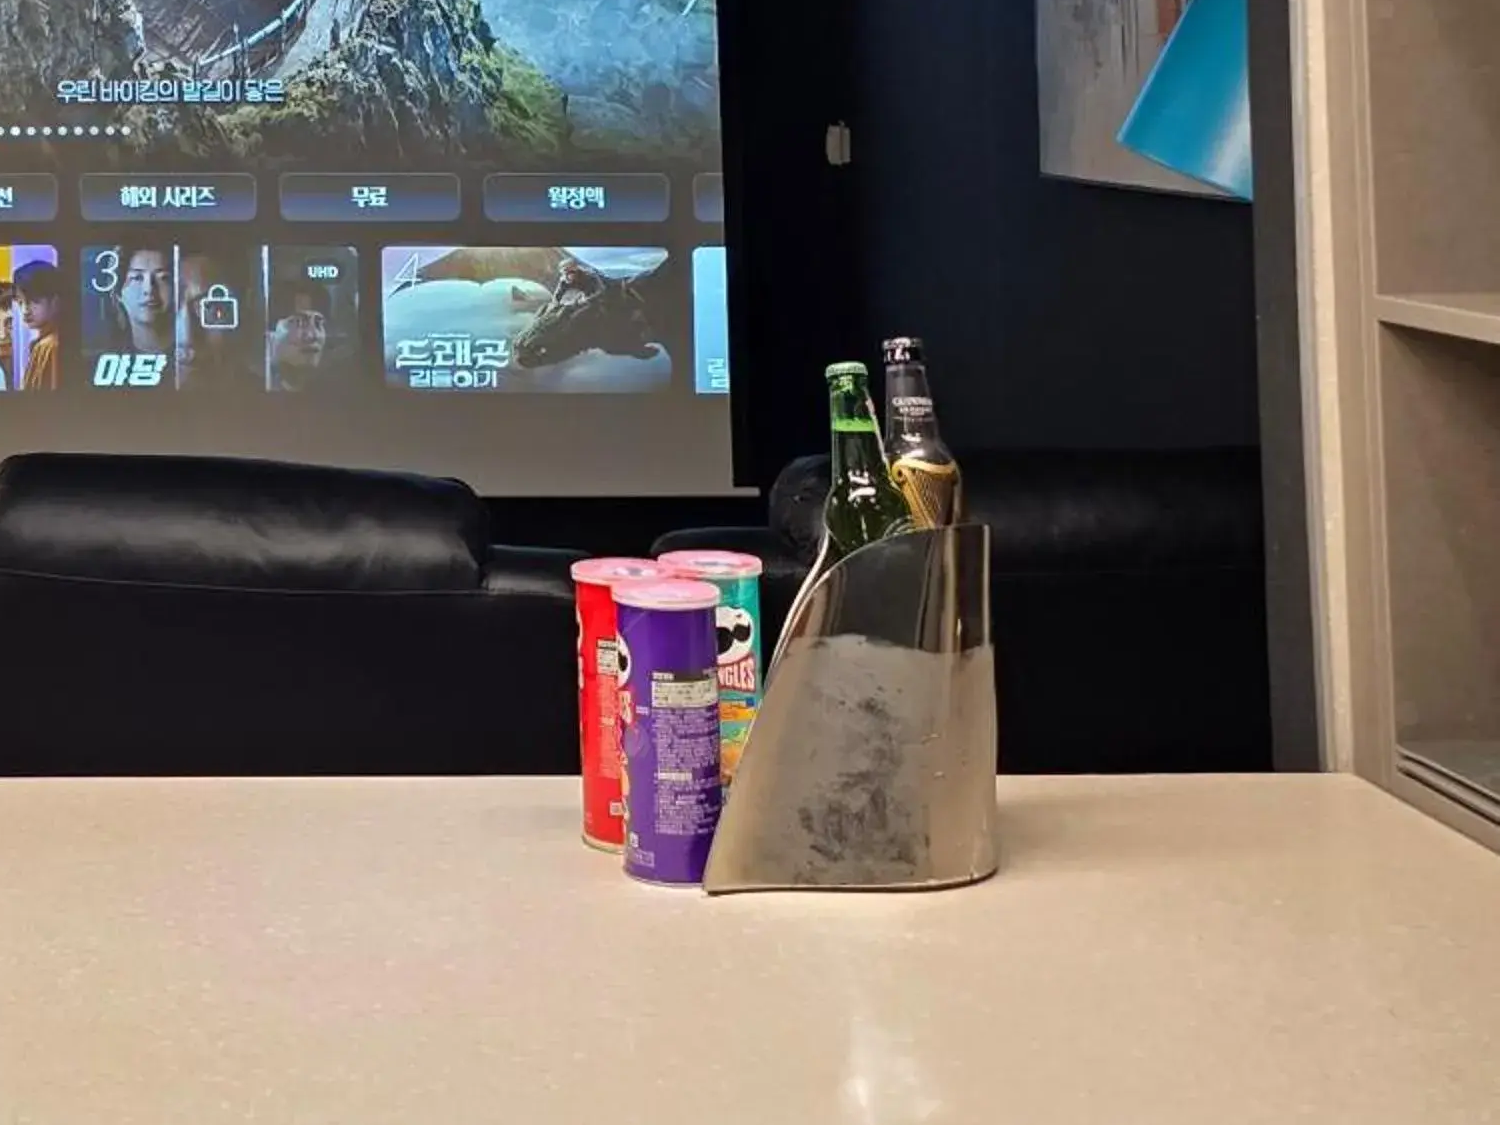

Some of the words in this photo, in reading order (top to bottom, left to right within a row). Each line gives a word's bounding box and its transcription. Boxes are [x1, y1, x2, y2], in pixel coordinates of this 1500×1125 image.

[56, 79, 97, 104] 우린
[100, 79, 179, 103] 바이킹의
[182, 78, 241, 103] 발길이
[244, 78, 286, 103] 닿은
[119, 185, 157, 209] 해외
[162, 185, 217, 208] 시리즈
[351, 186, 389, 208] 무료
[547, 186, 606, 210] 월정액
[91, 250, 119, 292] 3
[307, 266, 339, 278] UHD
[393, 252, 423, 291] 4
[394, 338, 510, 369] 드래곤
